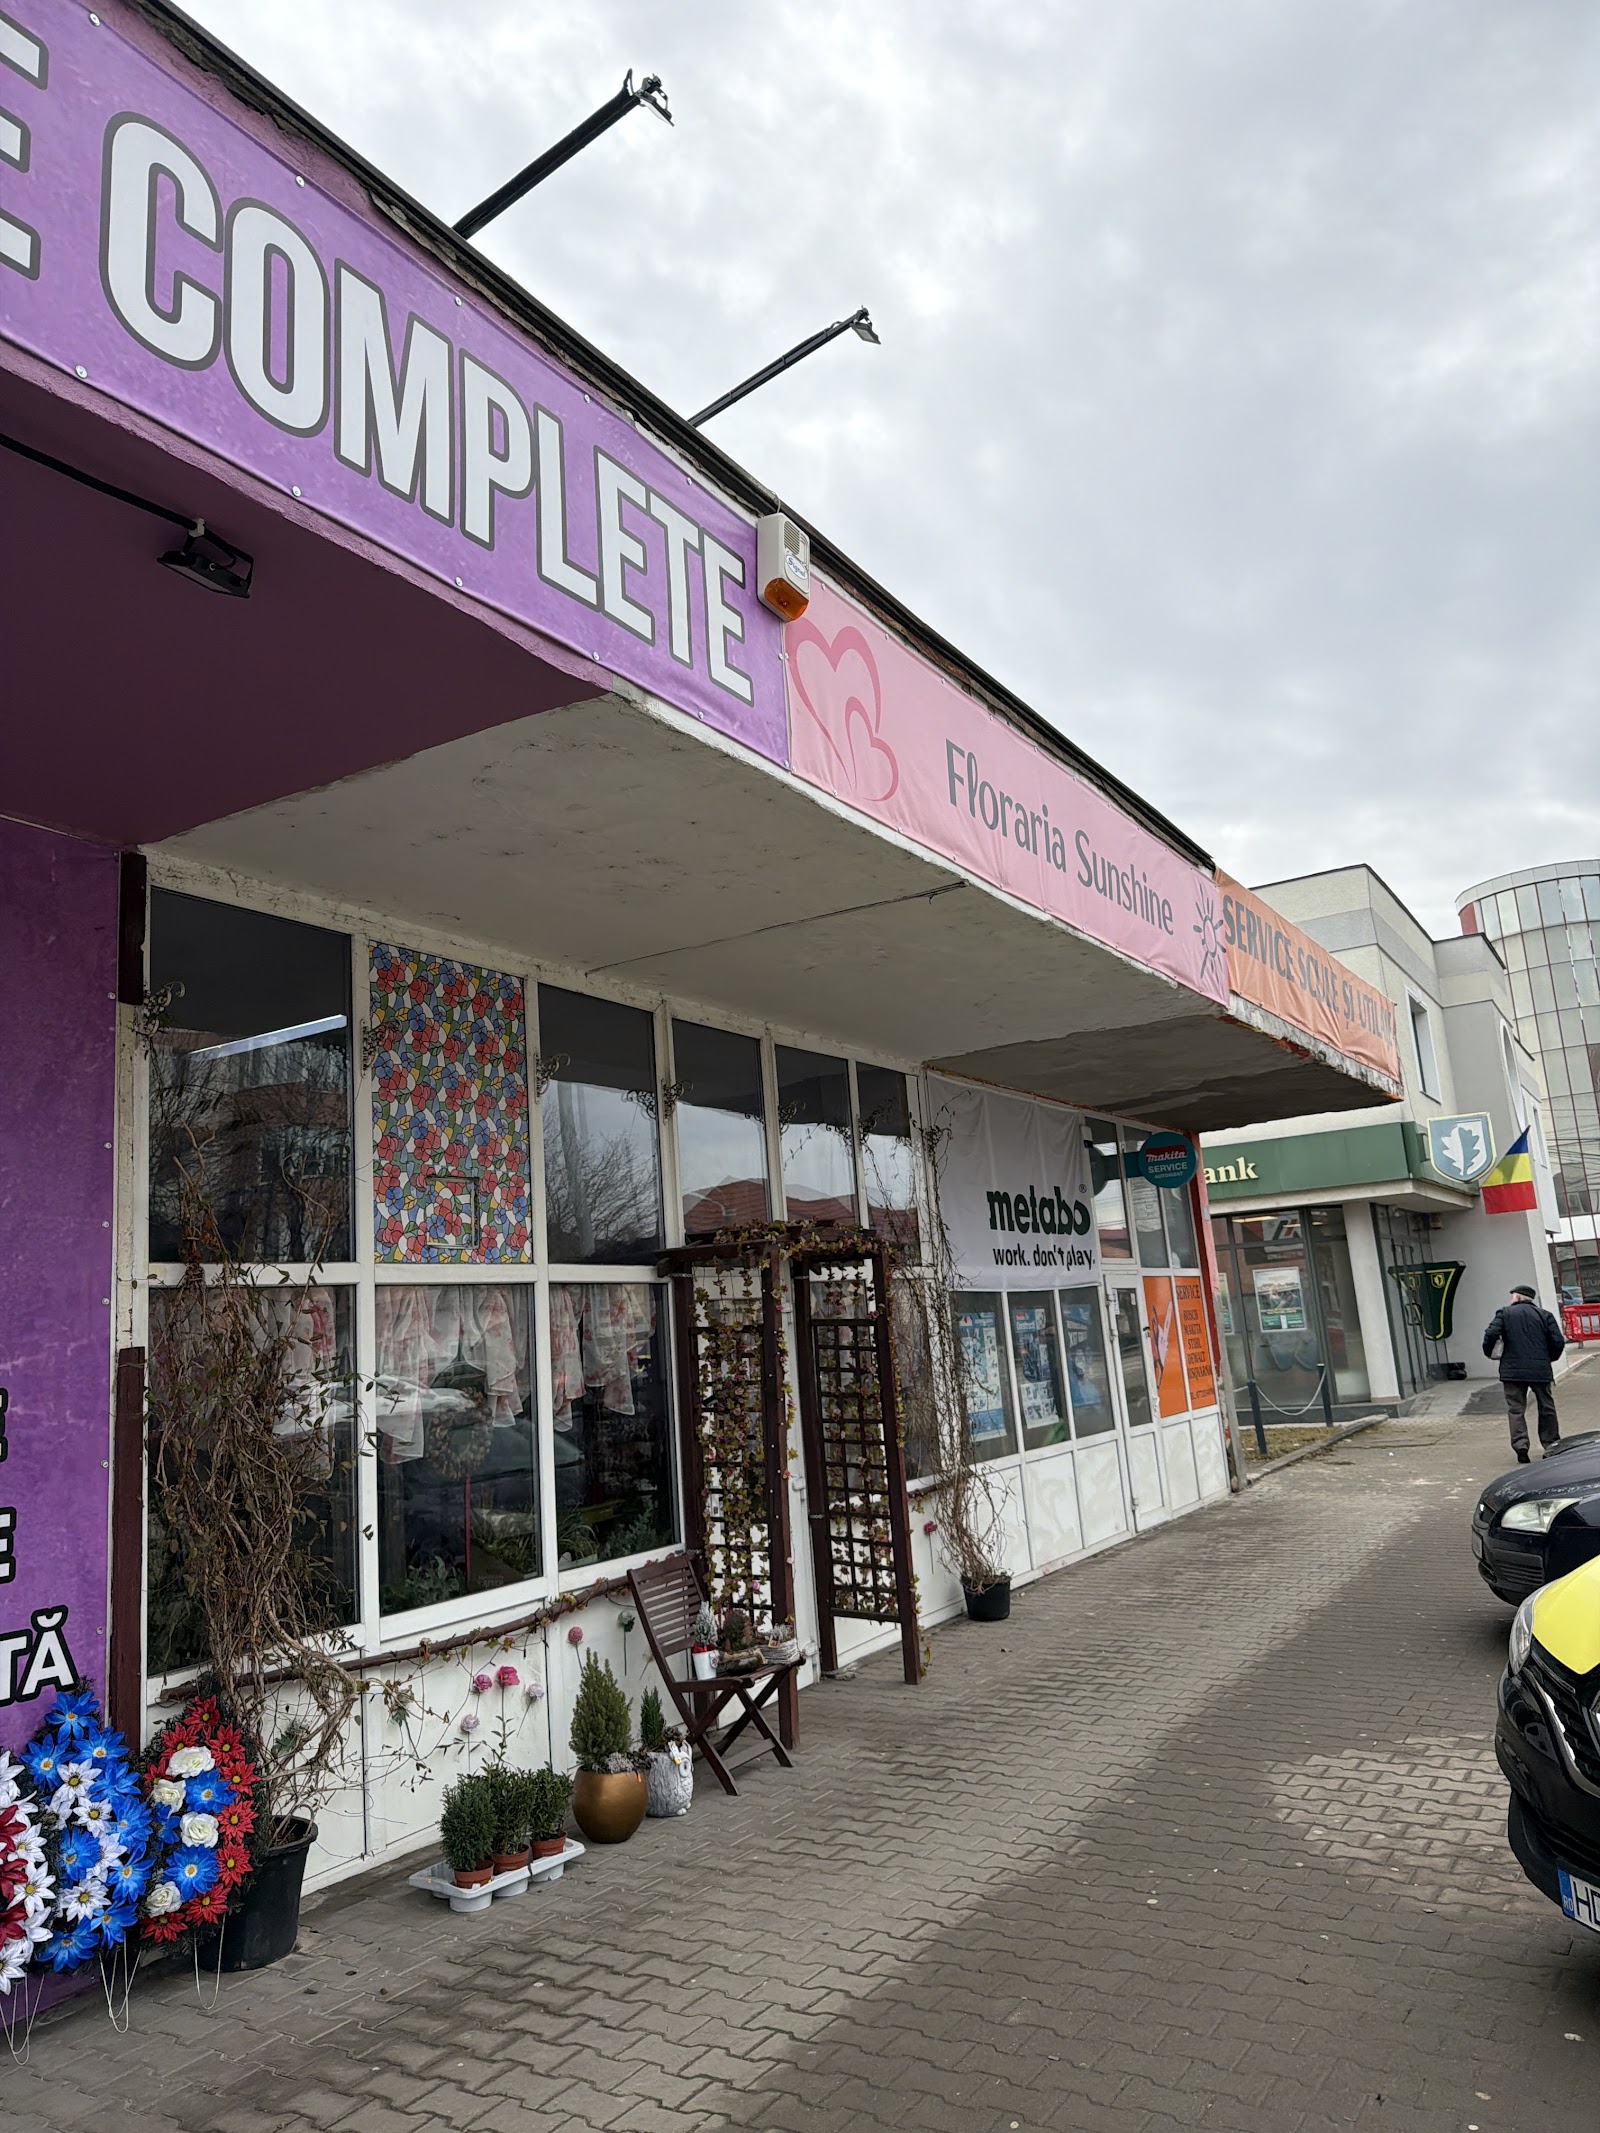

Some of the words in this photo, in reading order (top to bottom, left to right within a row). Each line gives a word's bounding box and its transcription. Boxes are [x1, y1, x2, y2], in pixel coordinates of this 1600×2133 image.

[100, 111, 755, 708] COMPLETE
[945, 738, 1067, 873] Floraria
[1075, 829, 1174, 936] Sunshine
[1222, 894, 1295, 983] SERVICE
[1297, 946, 1340, 1014] SCULE
[1145, 1149, 1188, 1162] makita
[1148, 1161, 1188, 1174] SERVICE
[1203, 1156, 1259, 1185] ank
[986, 1185, 1091, 1236] metabo
[992, 1243, 1031, 1267] work.
[1033, 1243, 1065, 1267] don't
[1066, 1244, 1096, 1271] play.
[1176, 1285, 1201, 1300] SERVICE
